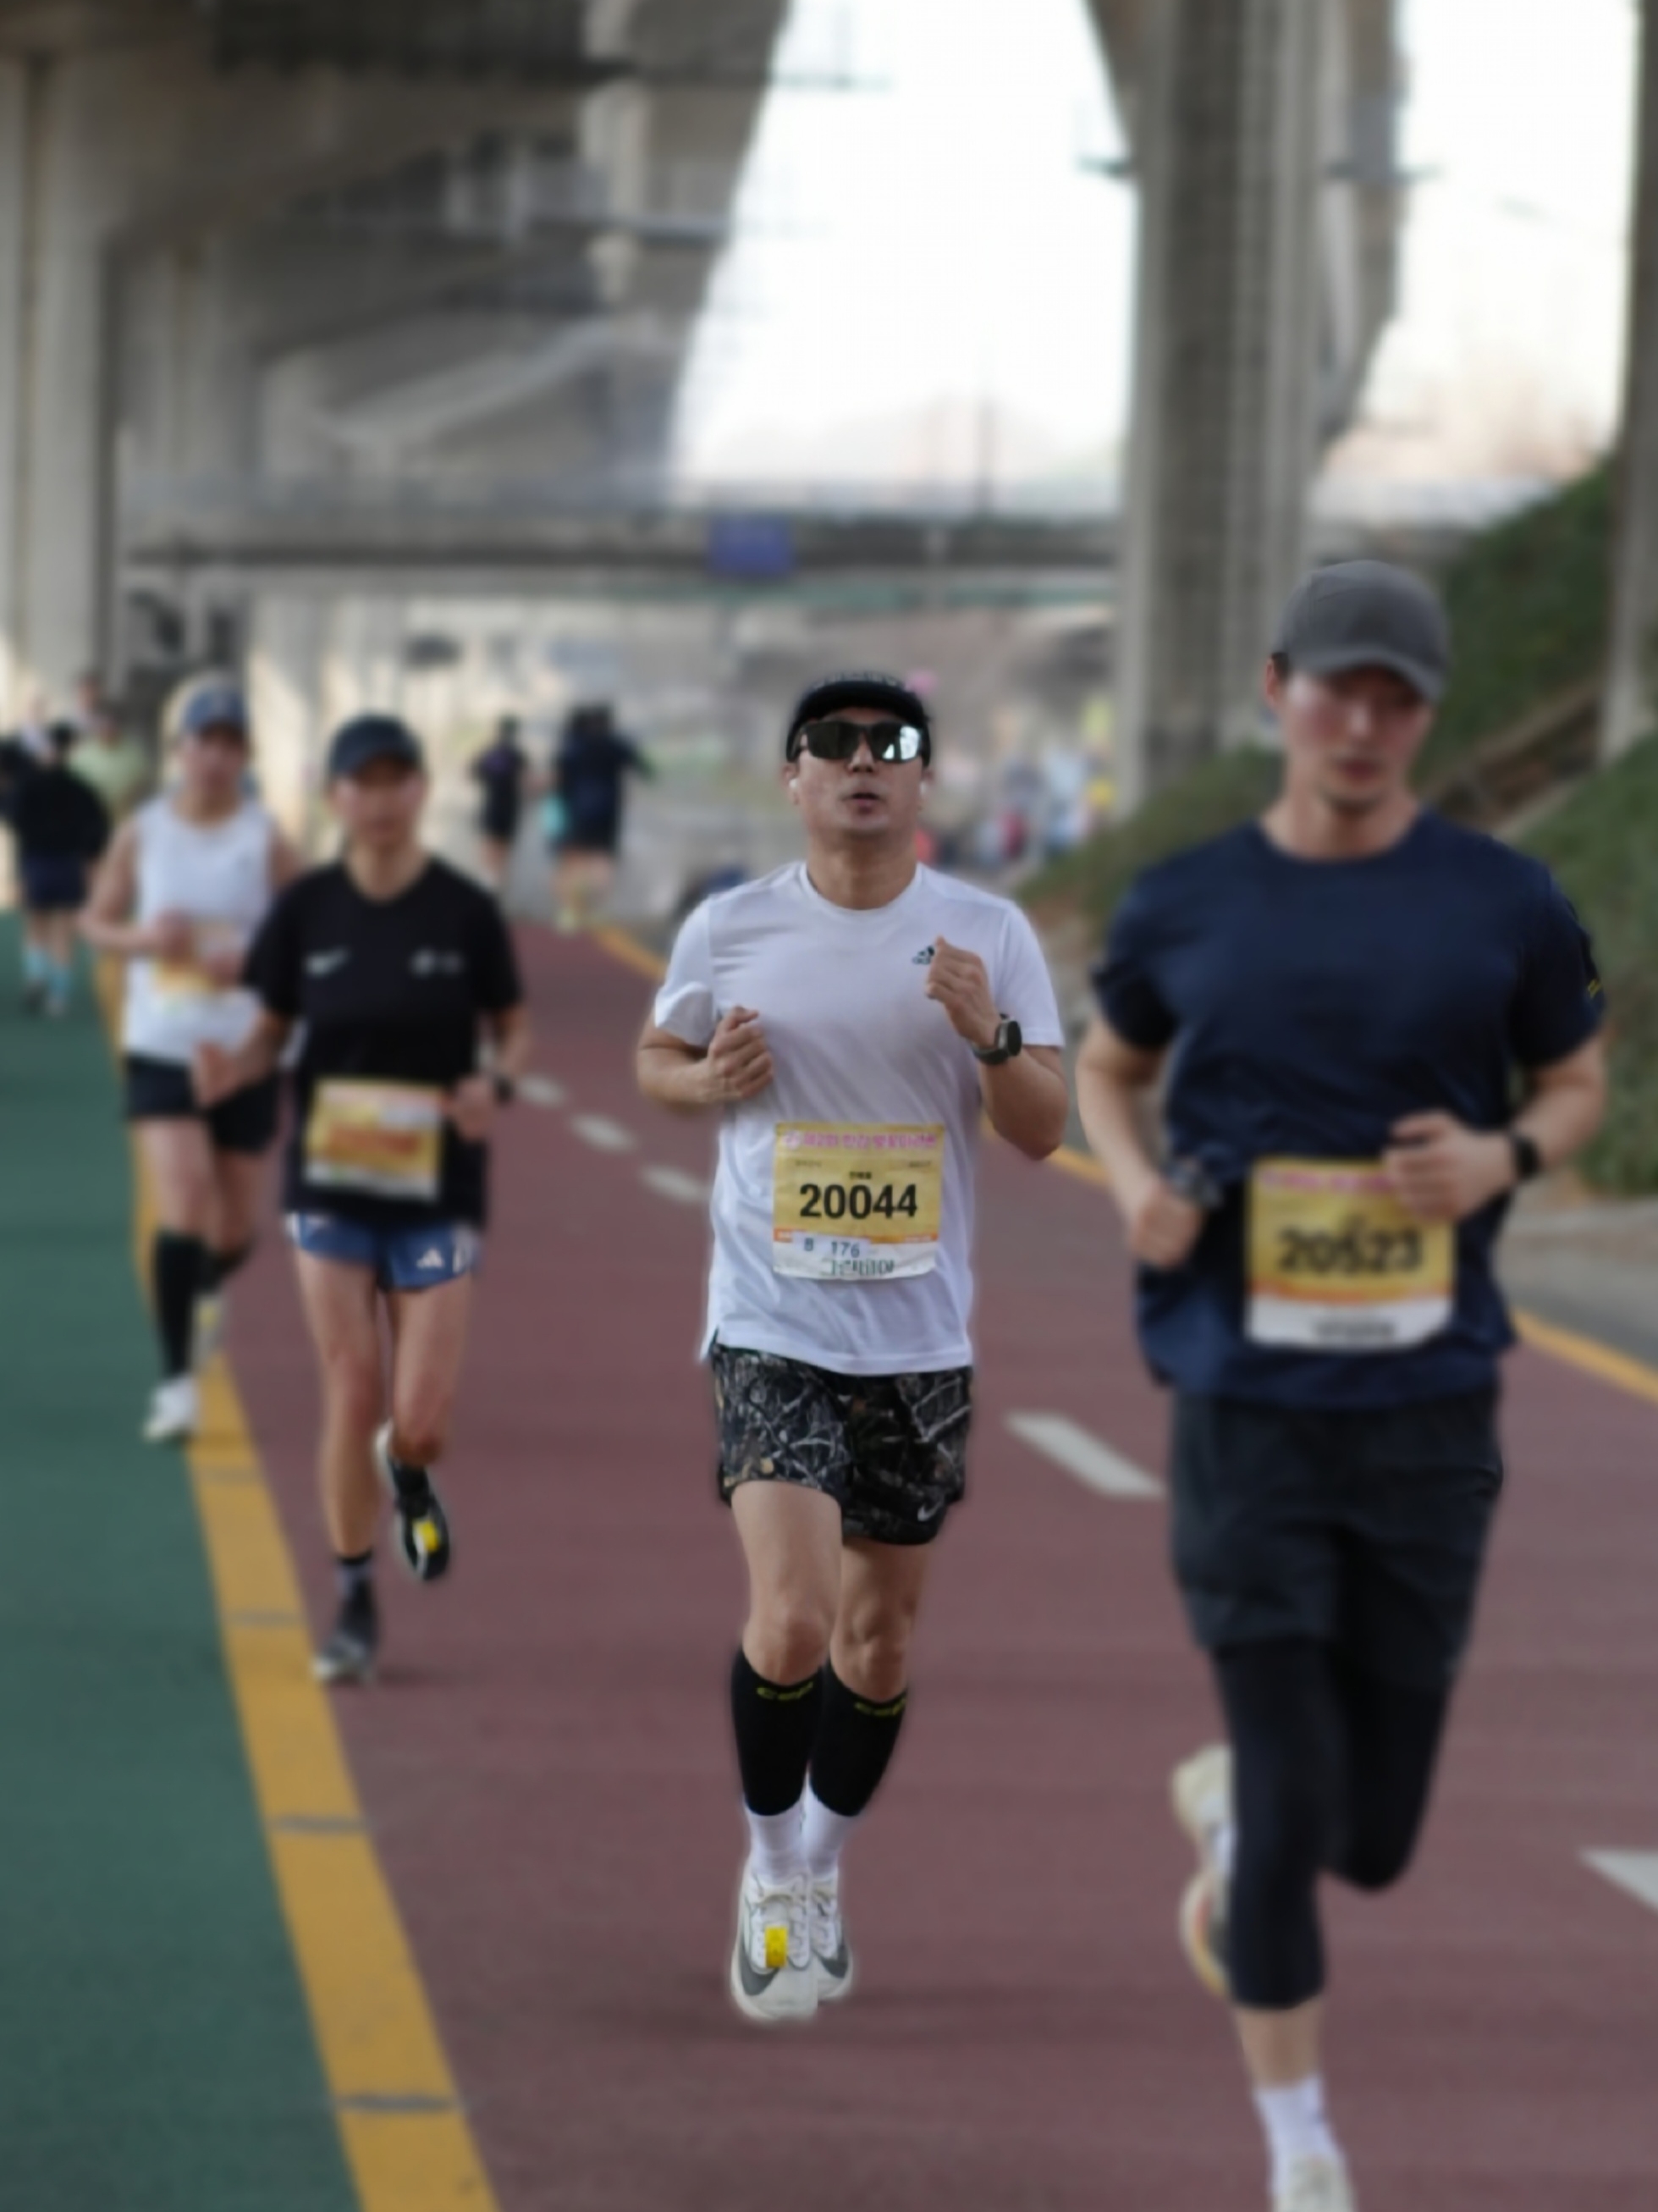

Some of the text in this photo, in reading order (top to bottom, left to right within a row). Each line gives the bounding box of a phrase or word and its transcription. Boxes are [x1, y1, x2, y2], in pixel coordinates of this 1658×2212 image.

[800, 1184, 917, 1219] 20044
[831, 1241, 860, 1258] 176
[1280, 1227, 1423, 1277] 20523
